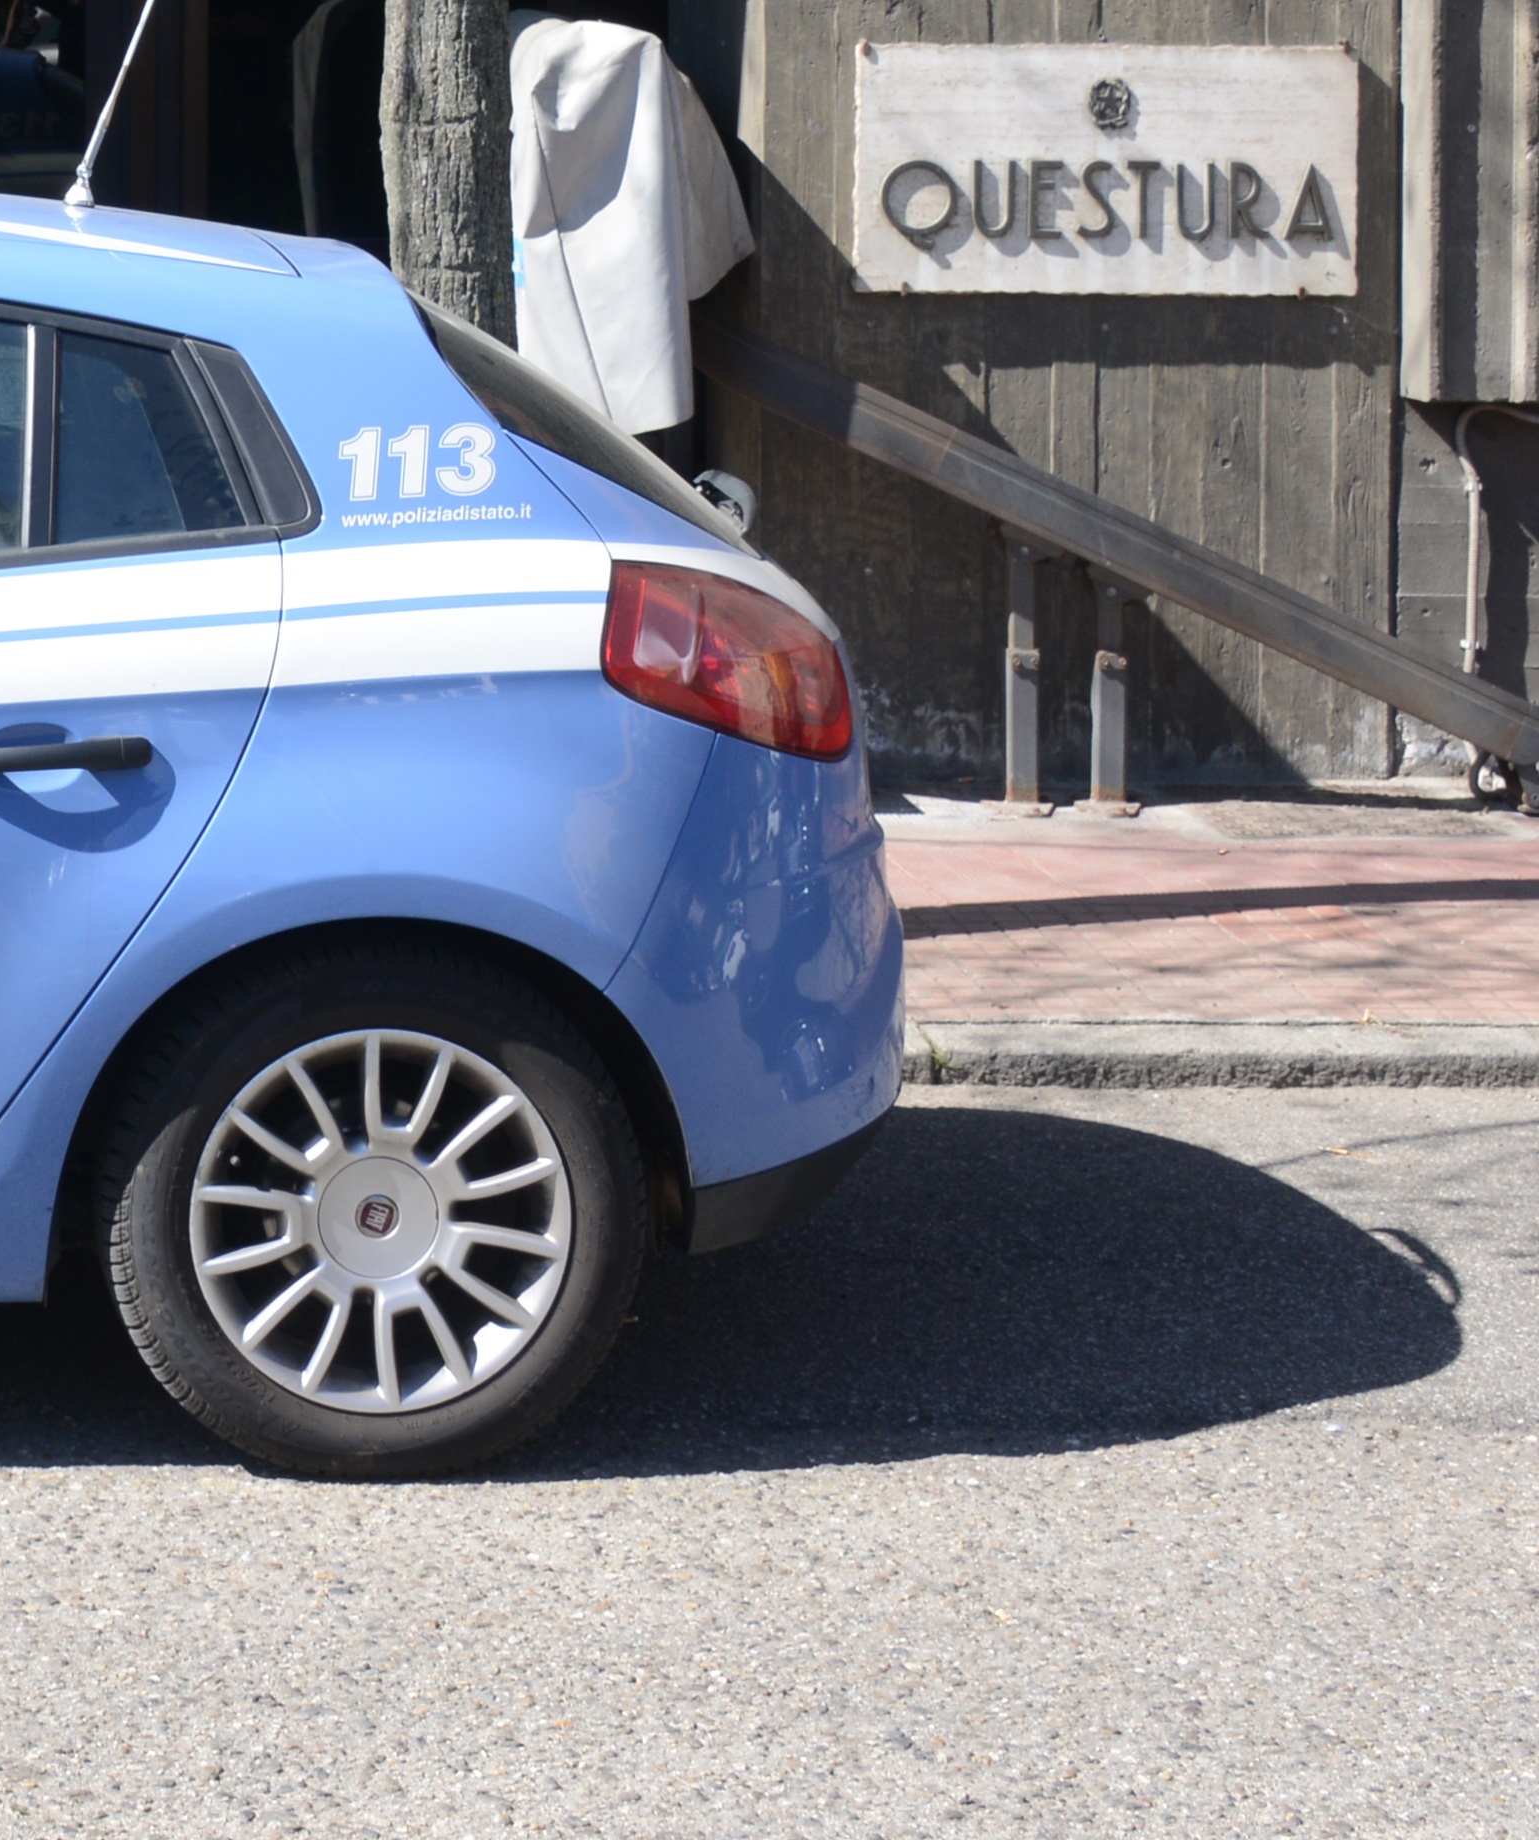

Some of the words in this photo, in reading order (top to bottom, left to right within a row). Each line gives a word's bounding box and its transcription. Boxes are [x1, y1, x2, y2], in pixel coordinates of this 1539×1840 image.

[880, 160, 1333, 250] QUESTURA
[338, 422, 496, 501] 113
[341, 504, 532, 528] www.poliziadistato.it
[365, 1202, 391, 1232] FIAT
